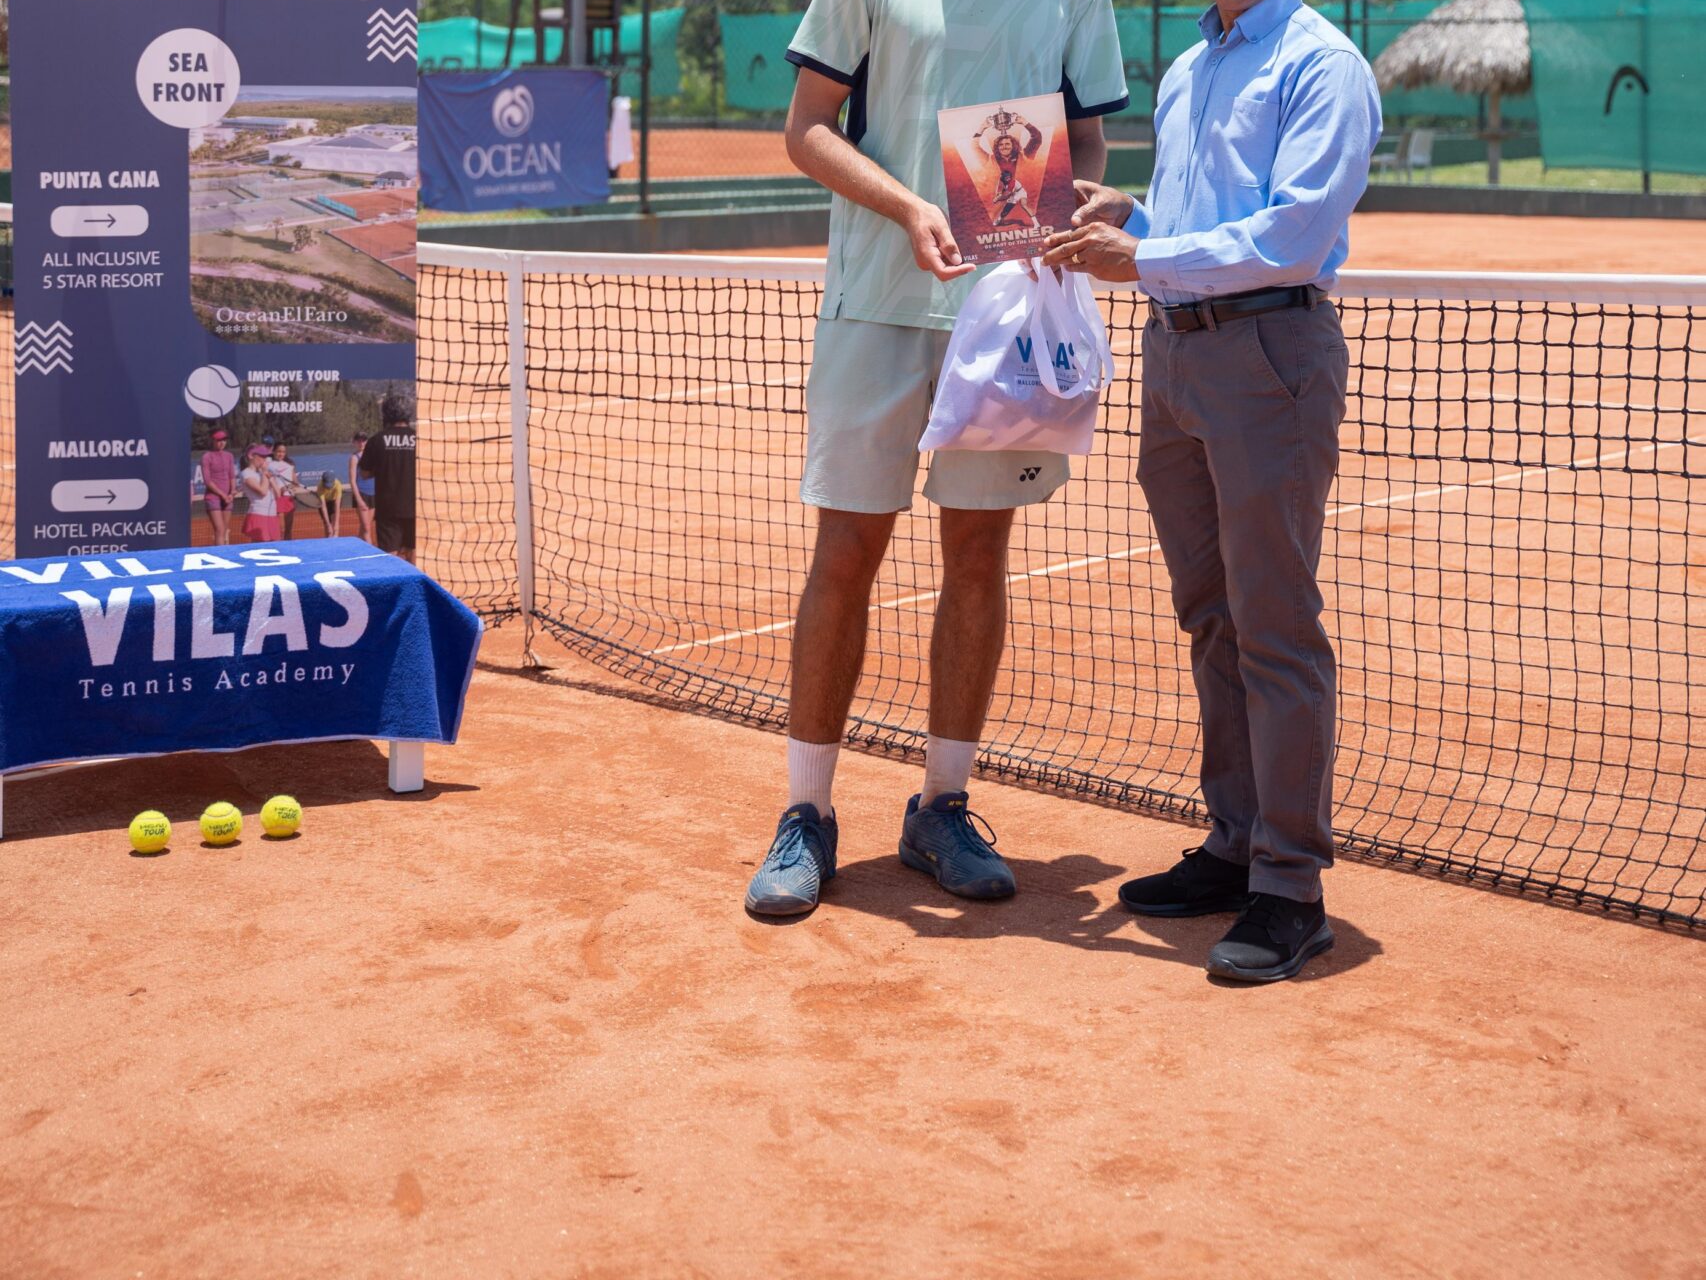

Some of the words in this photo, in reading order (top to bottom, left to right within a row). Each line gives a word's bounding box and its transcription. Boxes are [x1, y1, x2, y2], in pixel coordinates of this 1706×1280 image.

[168, 52, 208, 73] SEA
[153, 82, 225, 103] FRONT
[463, 141, 562, 180] OCEAN
[40, 170, 102, 189] PUNTA
[108, 170, 160, 189] CANA
[976, 225, 1054, 245] WINNER
[42, 252, 73, 267] ALL
[77, 251, 160, 267] INCLUSIVE
[42, 274, 53, 289] 5
[57, 273, 98, 289] STAR
[101, 273, 164, 288] RESORT
[247, 370, 303, 382] IMPROVE
[307, 370, 340, 382] YOUR
[247, 386, 290, 398] TENNIS
[247, 402, 261, 414] IN
[264, 401, 323, 413] PARADISE
[48, 439, 149, 459] MALLORCA
[383, 434, 416, 447] VILAS
[34, 523, 87, 539] HOTEL
[92, 521, 167, 537] PACKAGE
[0, 548, 302, 585] VILAS
[59, 570, 370, 667] VILAS
[78, 673, 192, 699] Tennis
[215, 662, 355, 690] Academy
[144, 828, 166, 836] TOUR
